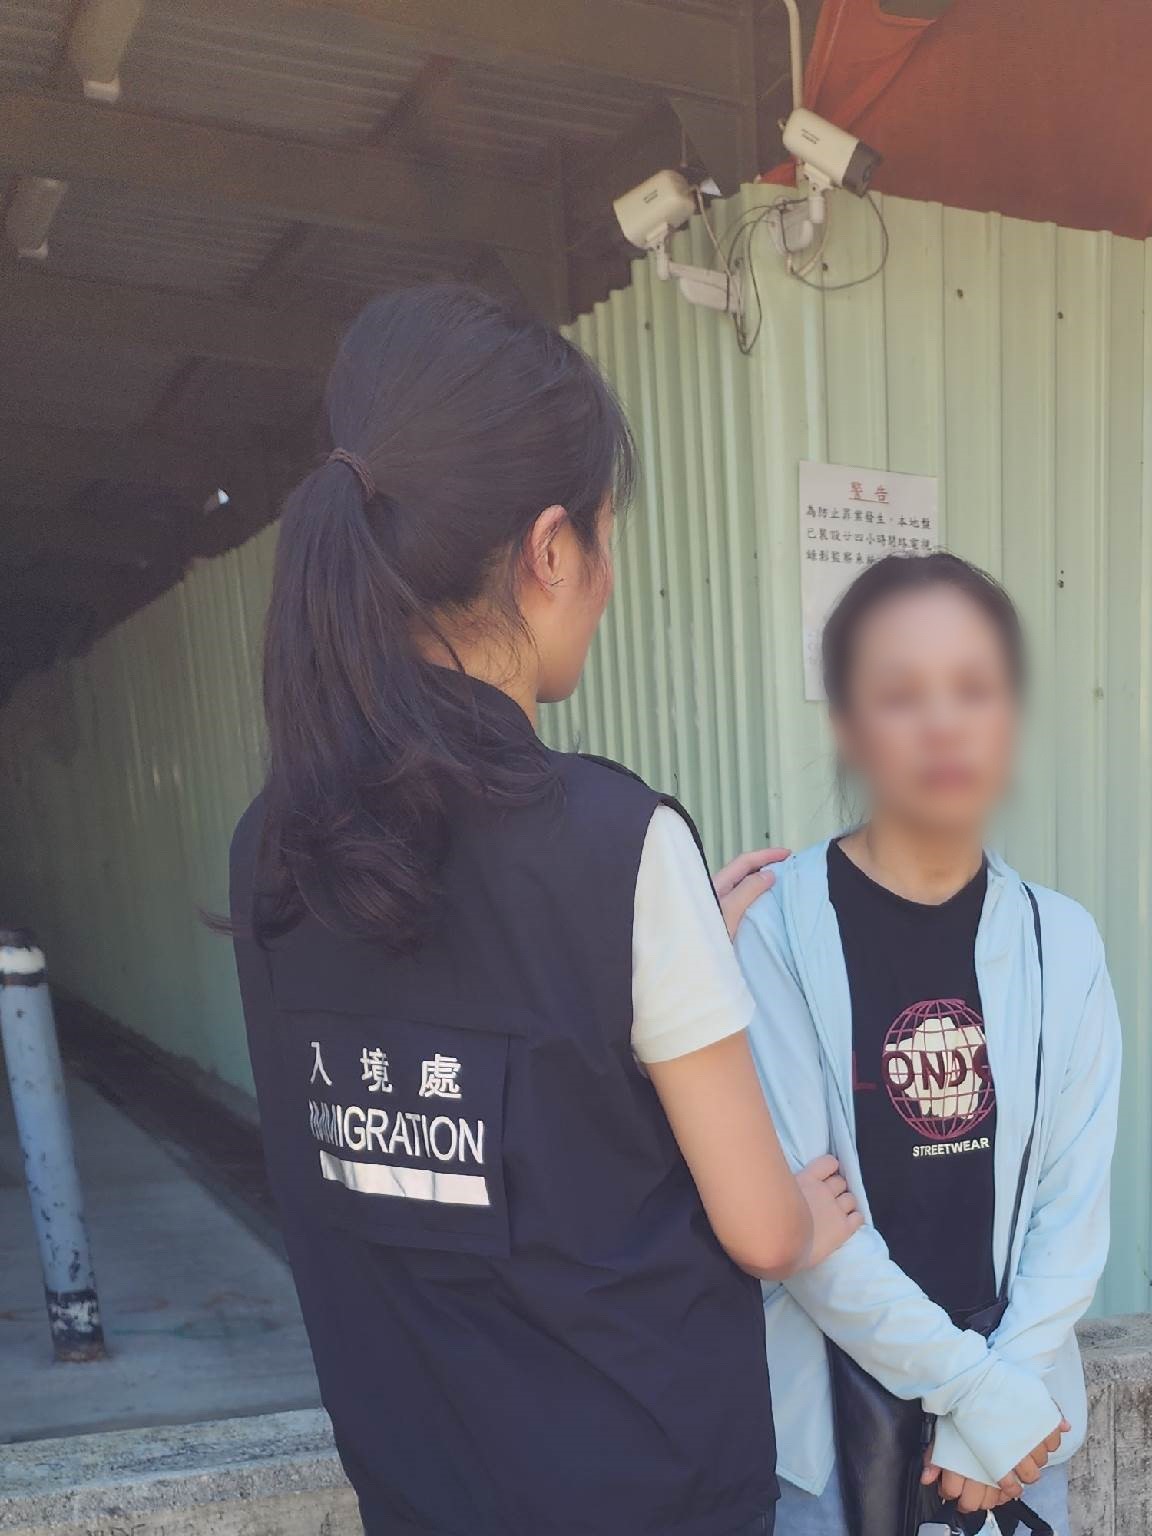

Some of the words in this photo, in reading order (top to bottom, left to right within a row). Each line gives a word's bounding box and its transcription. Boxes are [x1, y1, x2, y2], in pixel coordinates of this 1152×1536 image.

[309, 1041, 463, 1099] 入境處
[308, 1098, 485, 1165] IMMIGRATION
[912, 1137, 990, 1158] STREETWEAR
